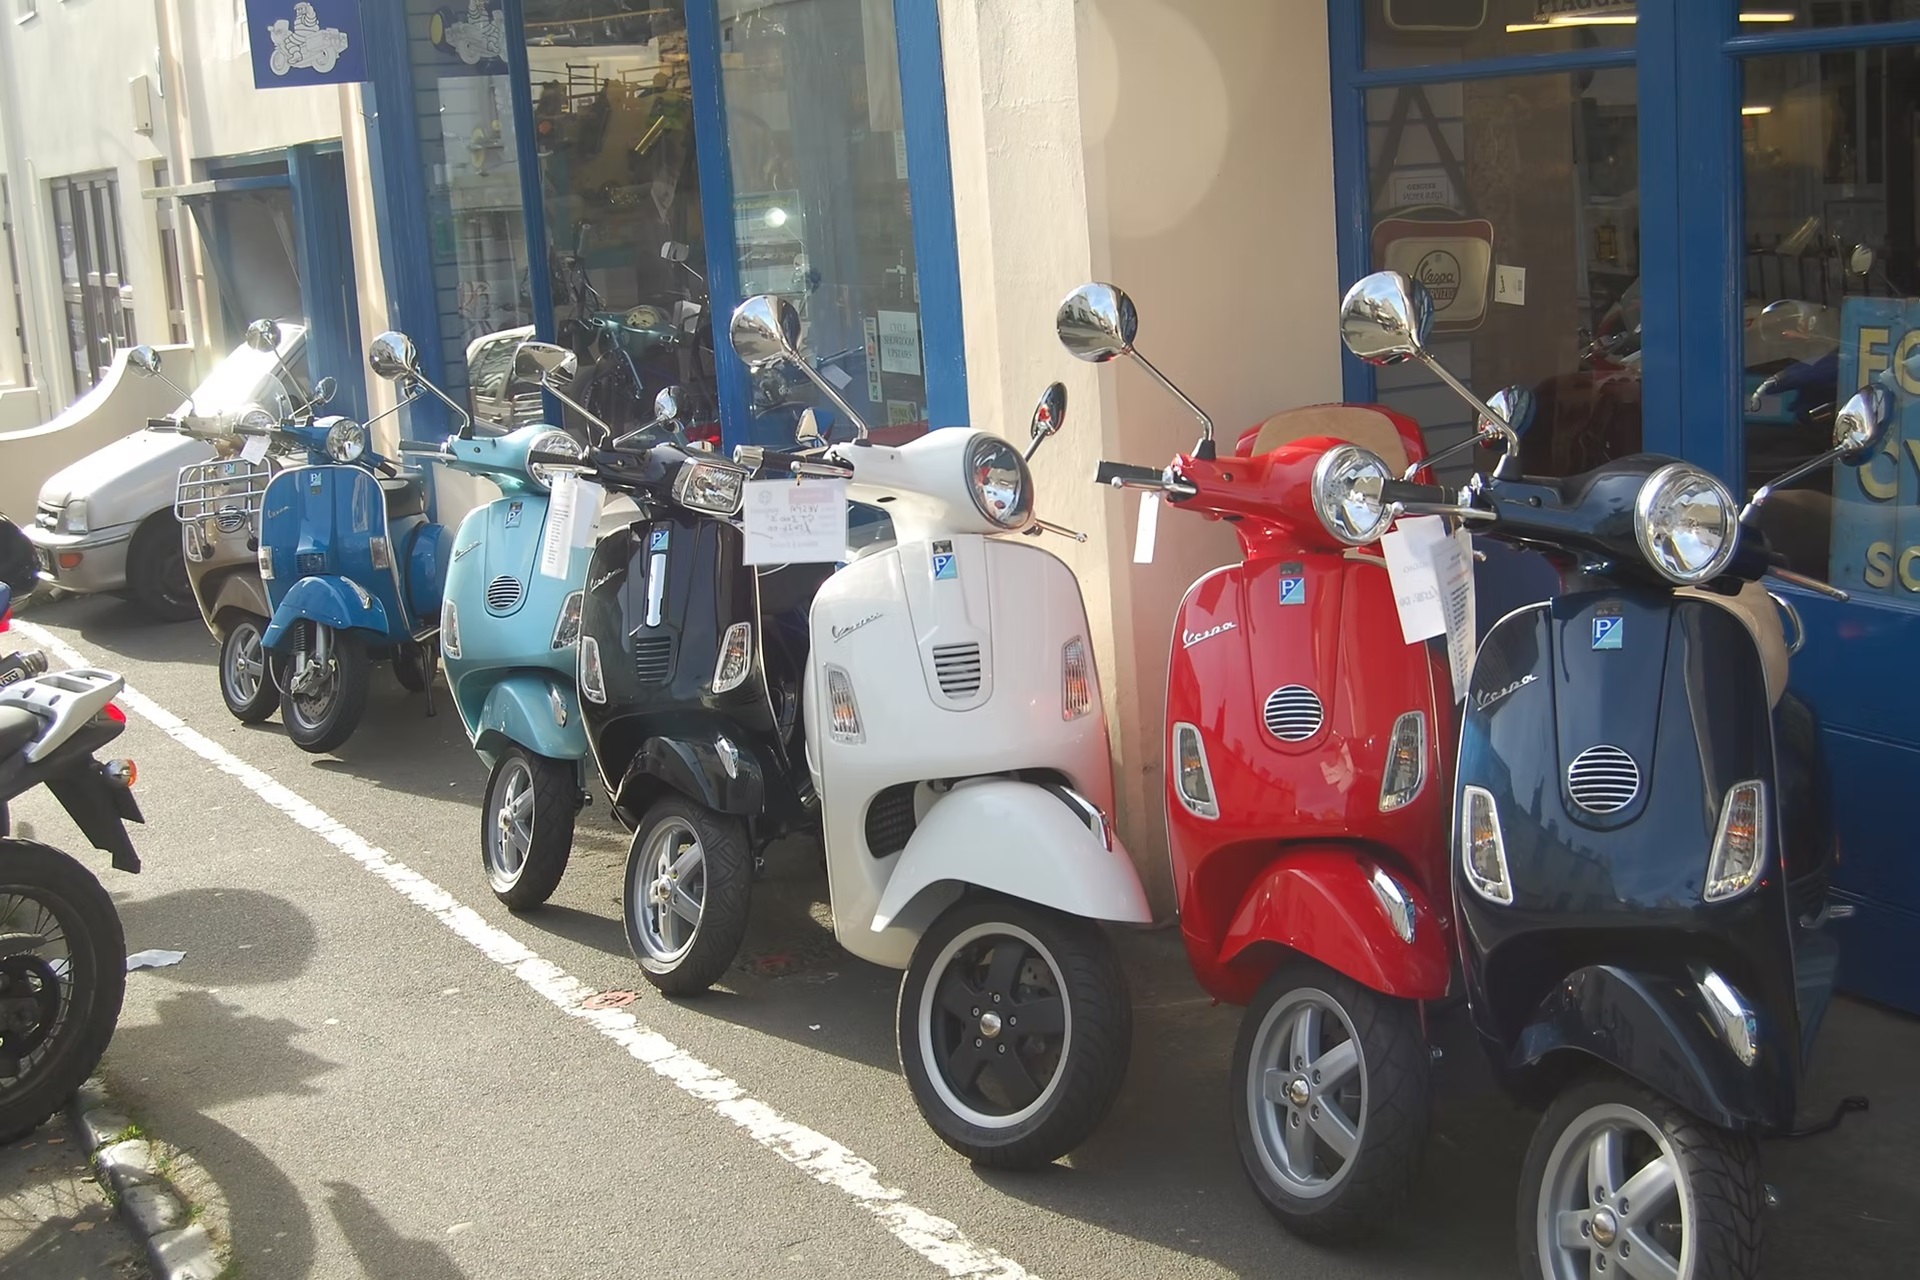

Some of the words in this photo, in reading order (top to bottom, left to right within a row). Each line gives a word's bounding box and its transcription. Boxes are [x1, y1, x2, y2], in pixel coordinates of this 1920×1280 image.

[1420, 259, 1455, 286] Vespa
[1427, 287, 1454, 300] RVIZIO
[1182, 620, 1238, 649] Vespa
[1476, 673, 1540, 712] Vespa
